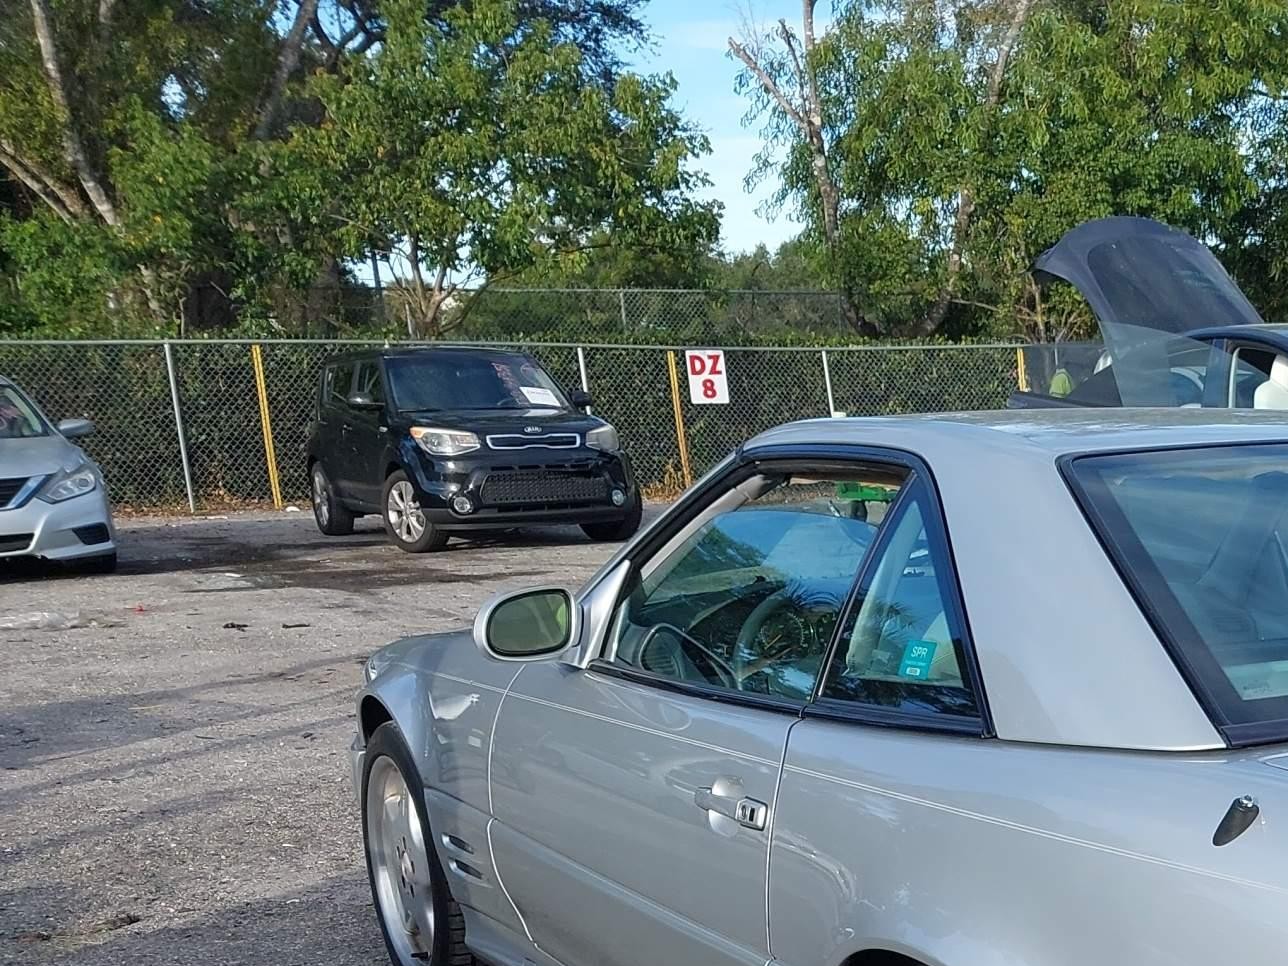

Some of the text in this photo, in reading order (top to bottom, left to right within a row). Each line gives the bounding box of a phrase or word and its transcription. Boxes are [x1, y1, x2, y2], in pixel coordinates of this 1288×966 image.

[688, 354, 723, 376] DZ
[702, 378, 718, 399] 8
[911, 646, 928, 658] SPR
